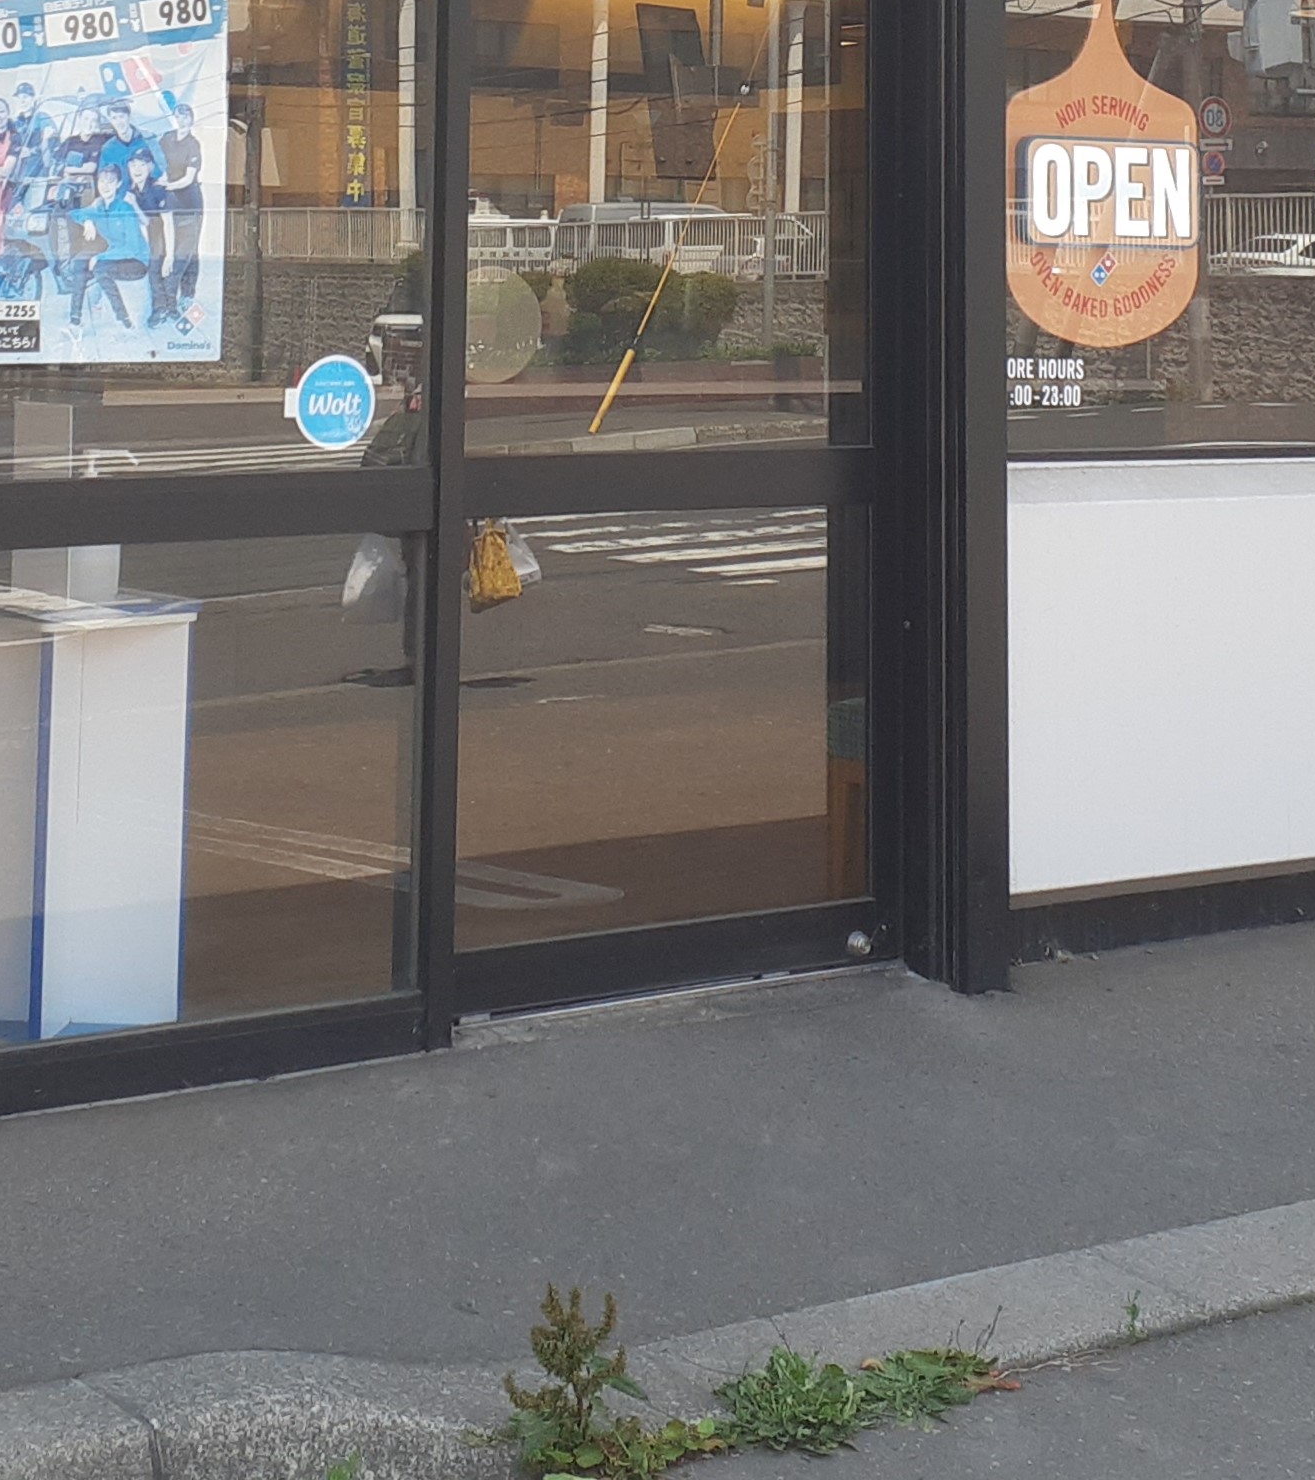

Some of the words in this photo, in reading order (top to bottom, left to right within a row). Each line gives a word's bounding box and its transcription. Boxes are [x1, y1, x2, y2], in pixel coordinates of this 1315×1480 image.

[64, 11, 115, 42] 980
[1055, 97, 1087, 129] NOW
[1091, 95, 1150, 132] SERVING
[1033, 143, 1191, 239] OPEN
[1029, 251, 1064, 297] OVEN
[1061, 287, 1108, 318] BAKED
[1113, 254, 1178, 317] GOODNESS
[1038, 358, 1085, 380] HOURS
[308, 391, 362, 416] Wolt
